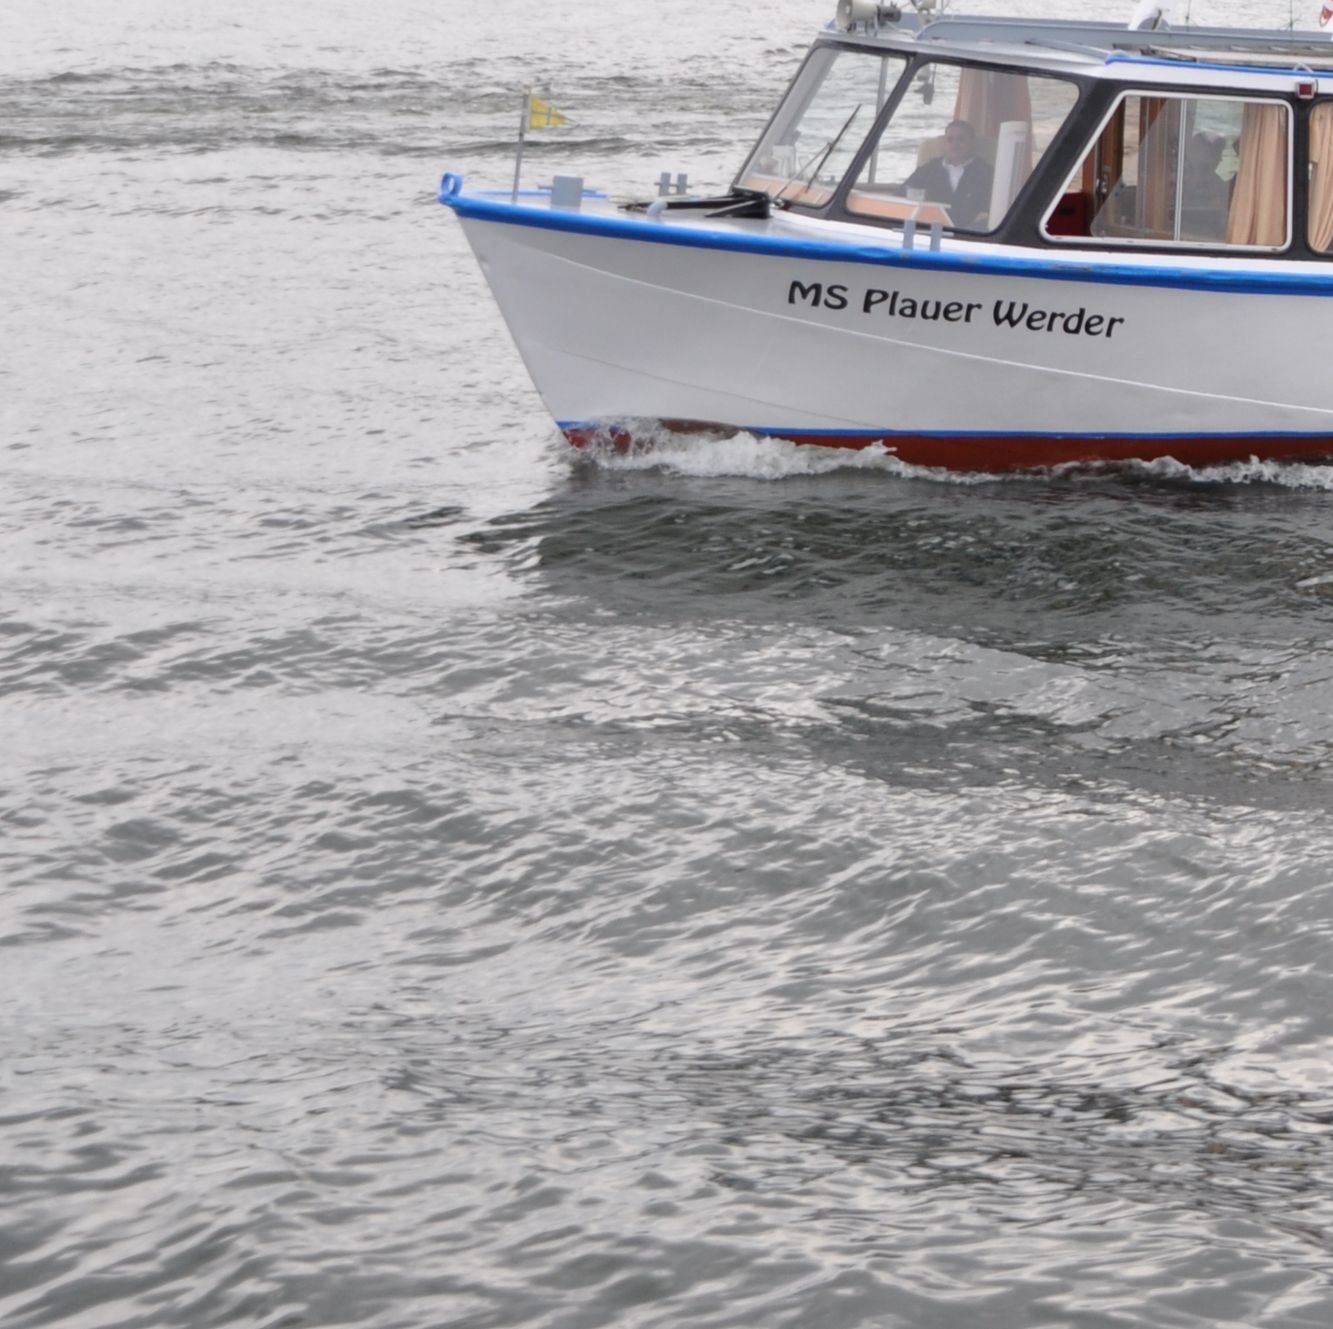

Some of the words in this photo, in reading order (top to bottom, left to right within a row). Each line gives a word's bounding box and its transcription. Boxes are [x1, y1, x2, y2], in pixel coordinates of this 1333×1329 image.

[788, 280, 848, 310] MS
[862, 289, 982, 322] Plauer
[993, 300, 1125, 338] Werder
